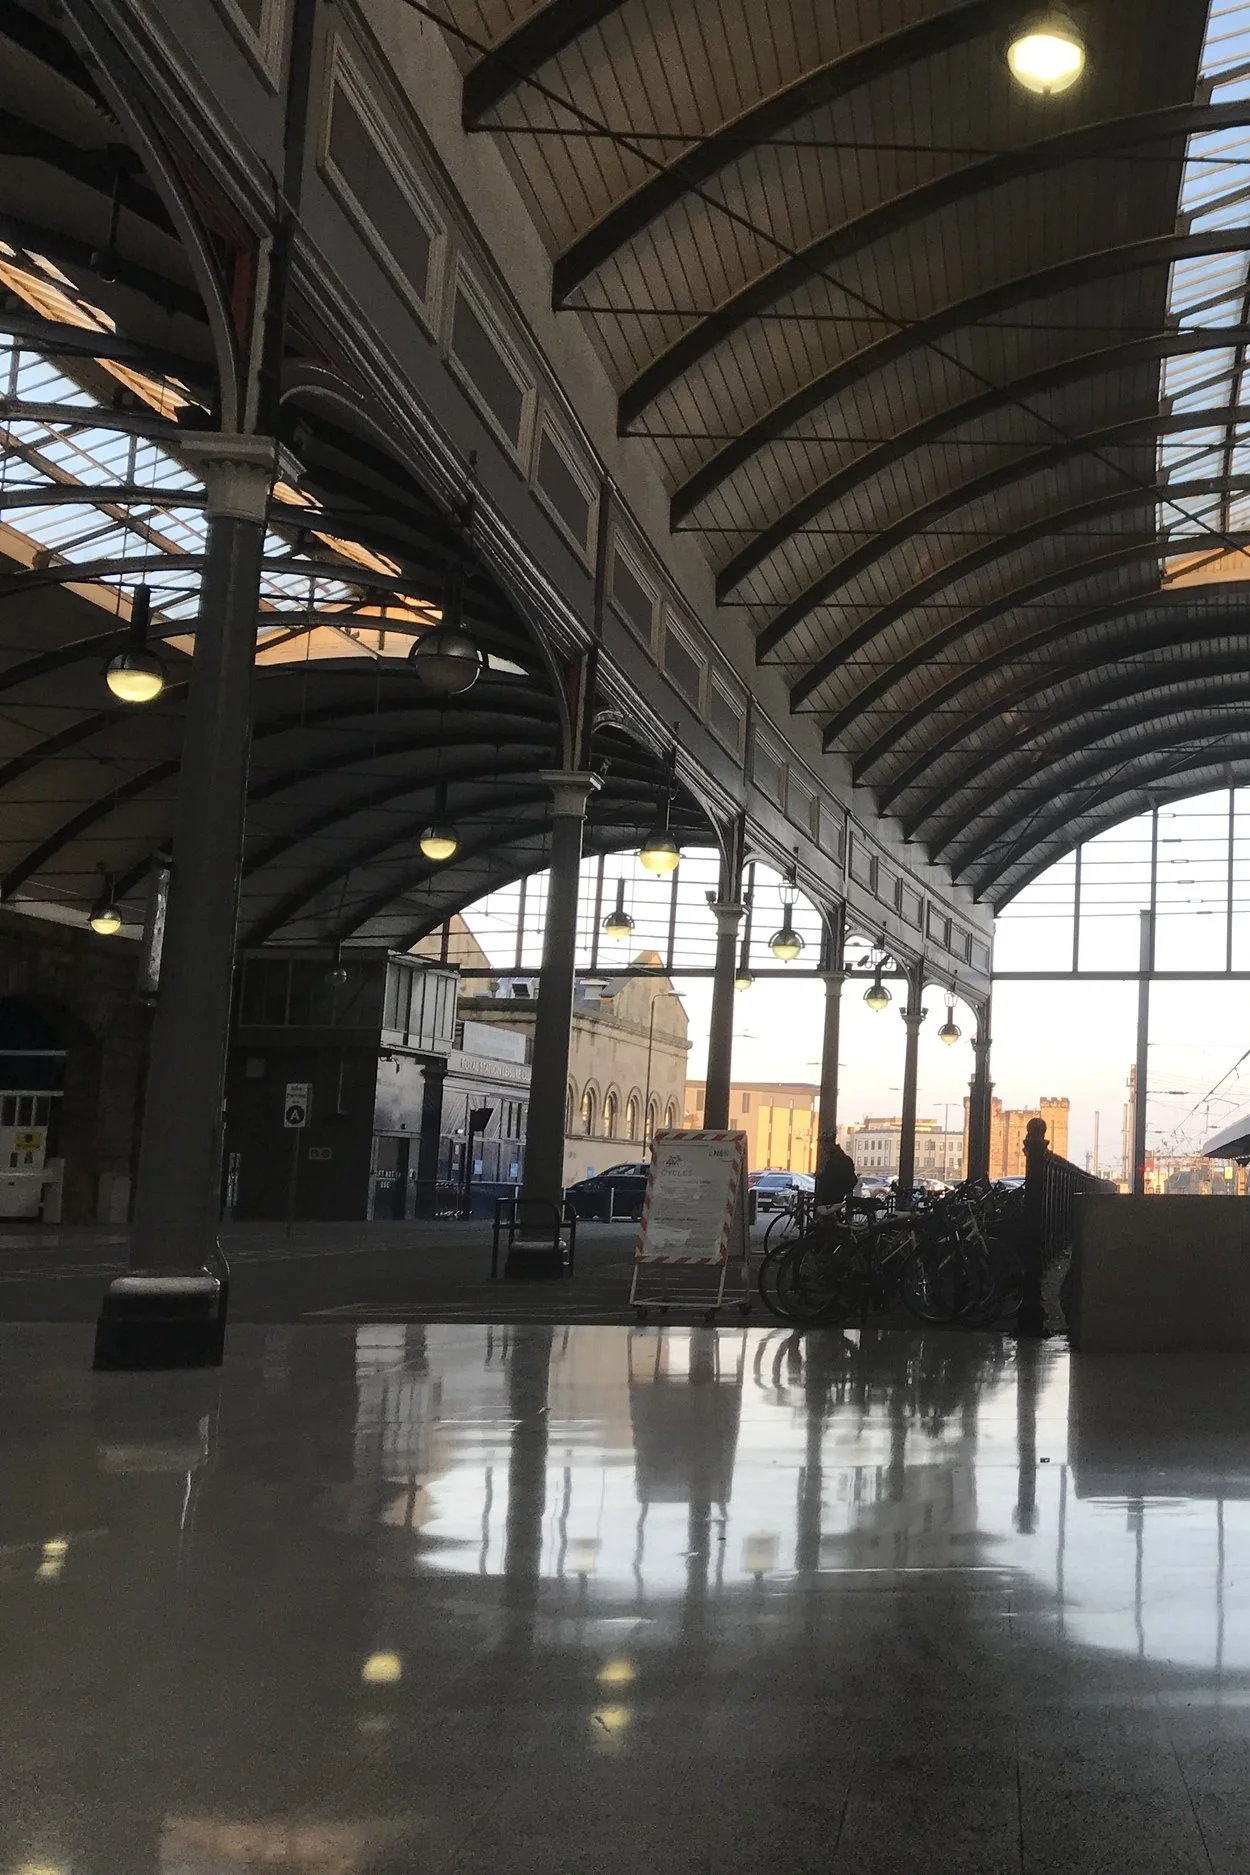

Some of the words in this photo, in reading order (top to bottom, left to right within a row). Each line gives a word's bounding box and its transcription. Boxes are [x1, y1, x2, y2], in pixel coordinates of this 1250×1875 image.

[478, 1060, 502, 1076] STATION
[290, 1109, 300, 1120] A
[661, 1169, 692, 1177] CYCLES
